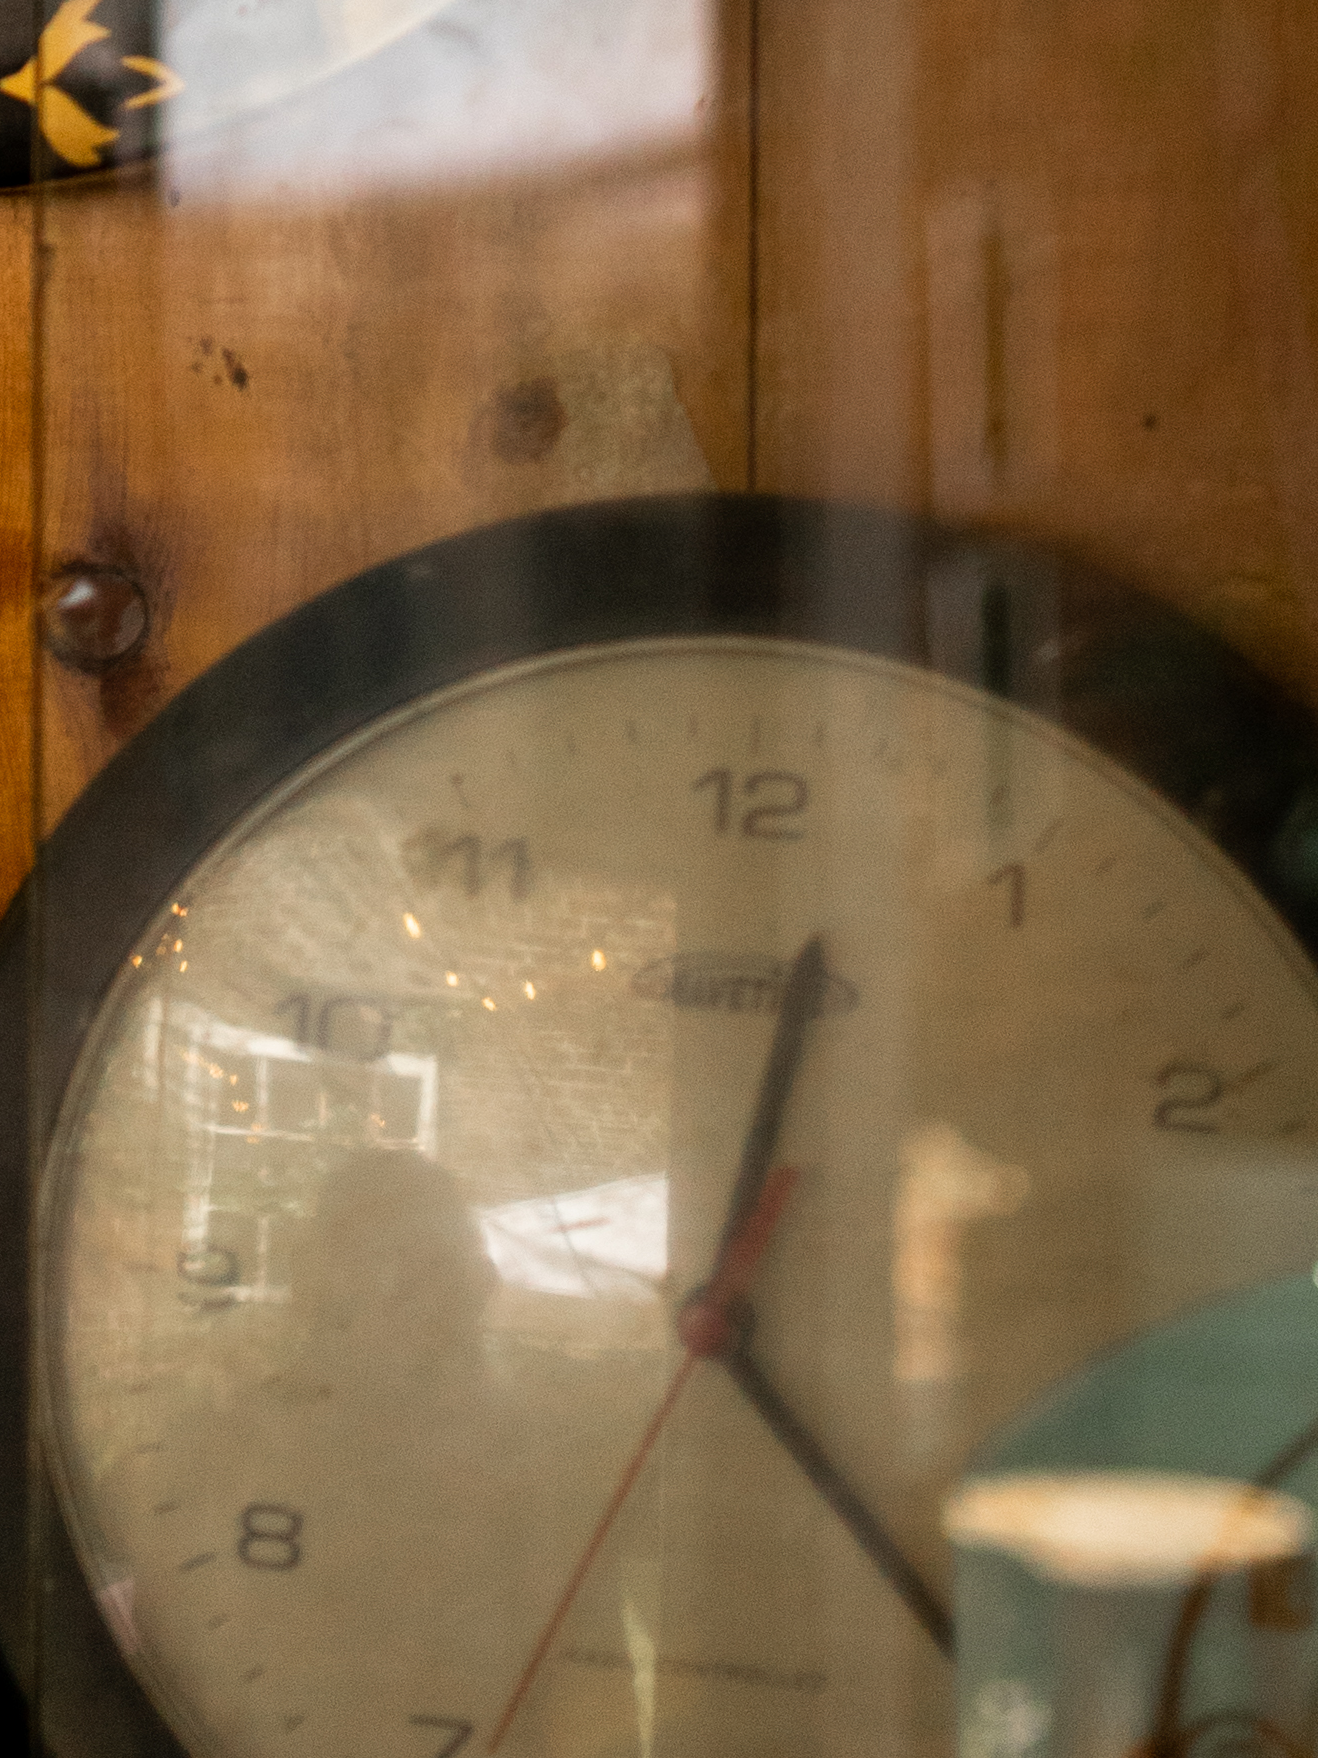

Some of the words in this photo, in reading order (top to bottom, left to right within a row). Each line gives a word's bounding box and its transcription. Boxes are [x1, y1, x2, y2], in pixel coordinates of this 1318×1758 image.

[689, 767, 813, 842] 12
[985, 861, 1030, 931] 1
[1151, 1060, 1225, 1136] 2
[236, 1503, 305, 1572] 8
